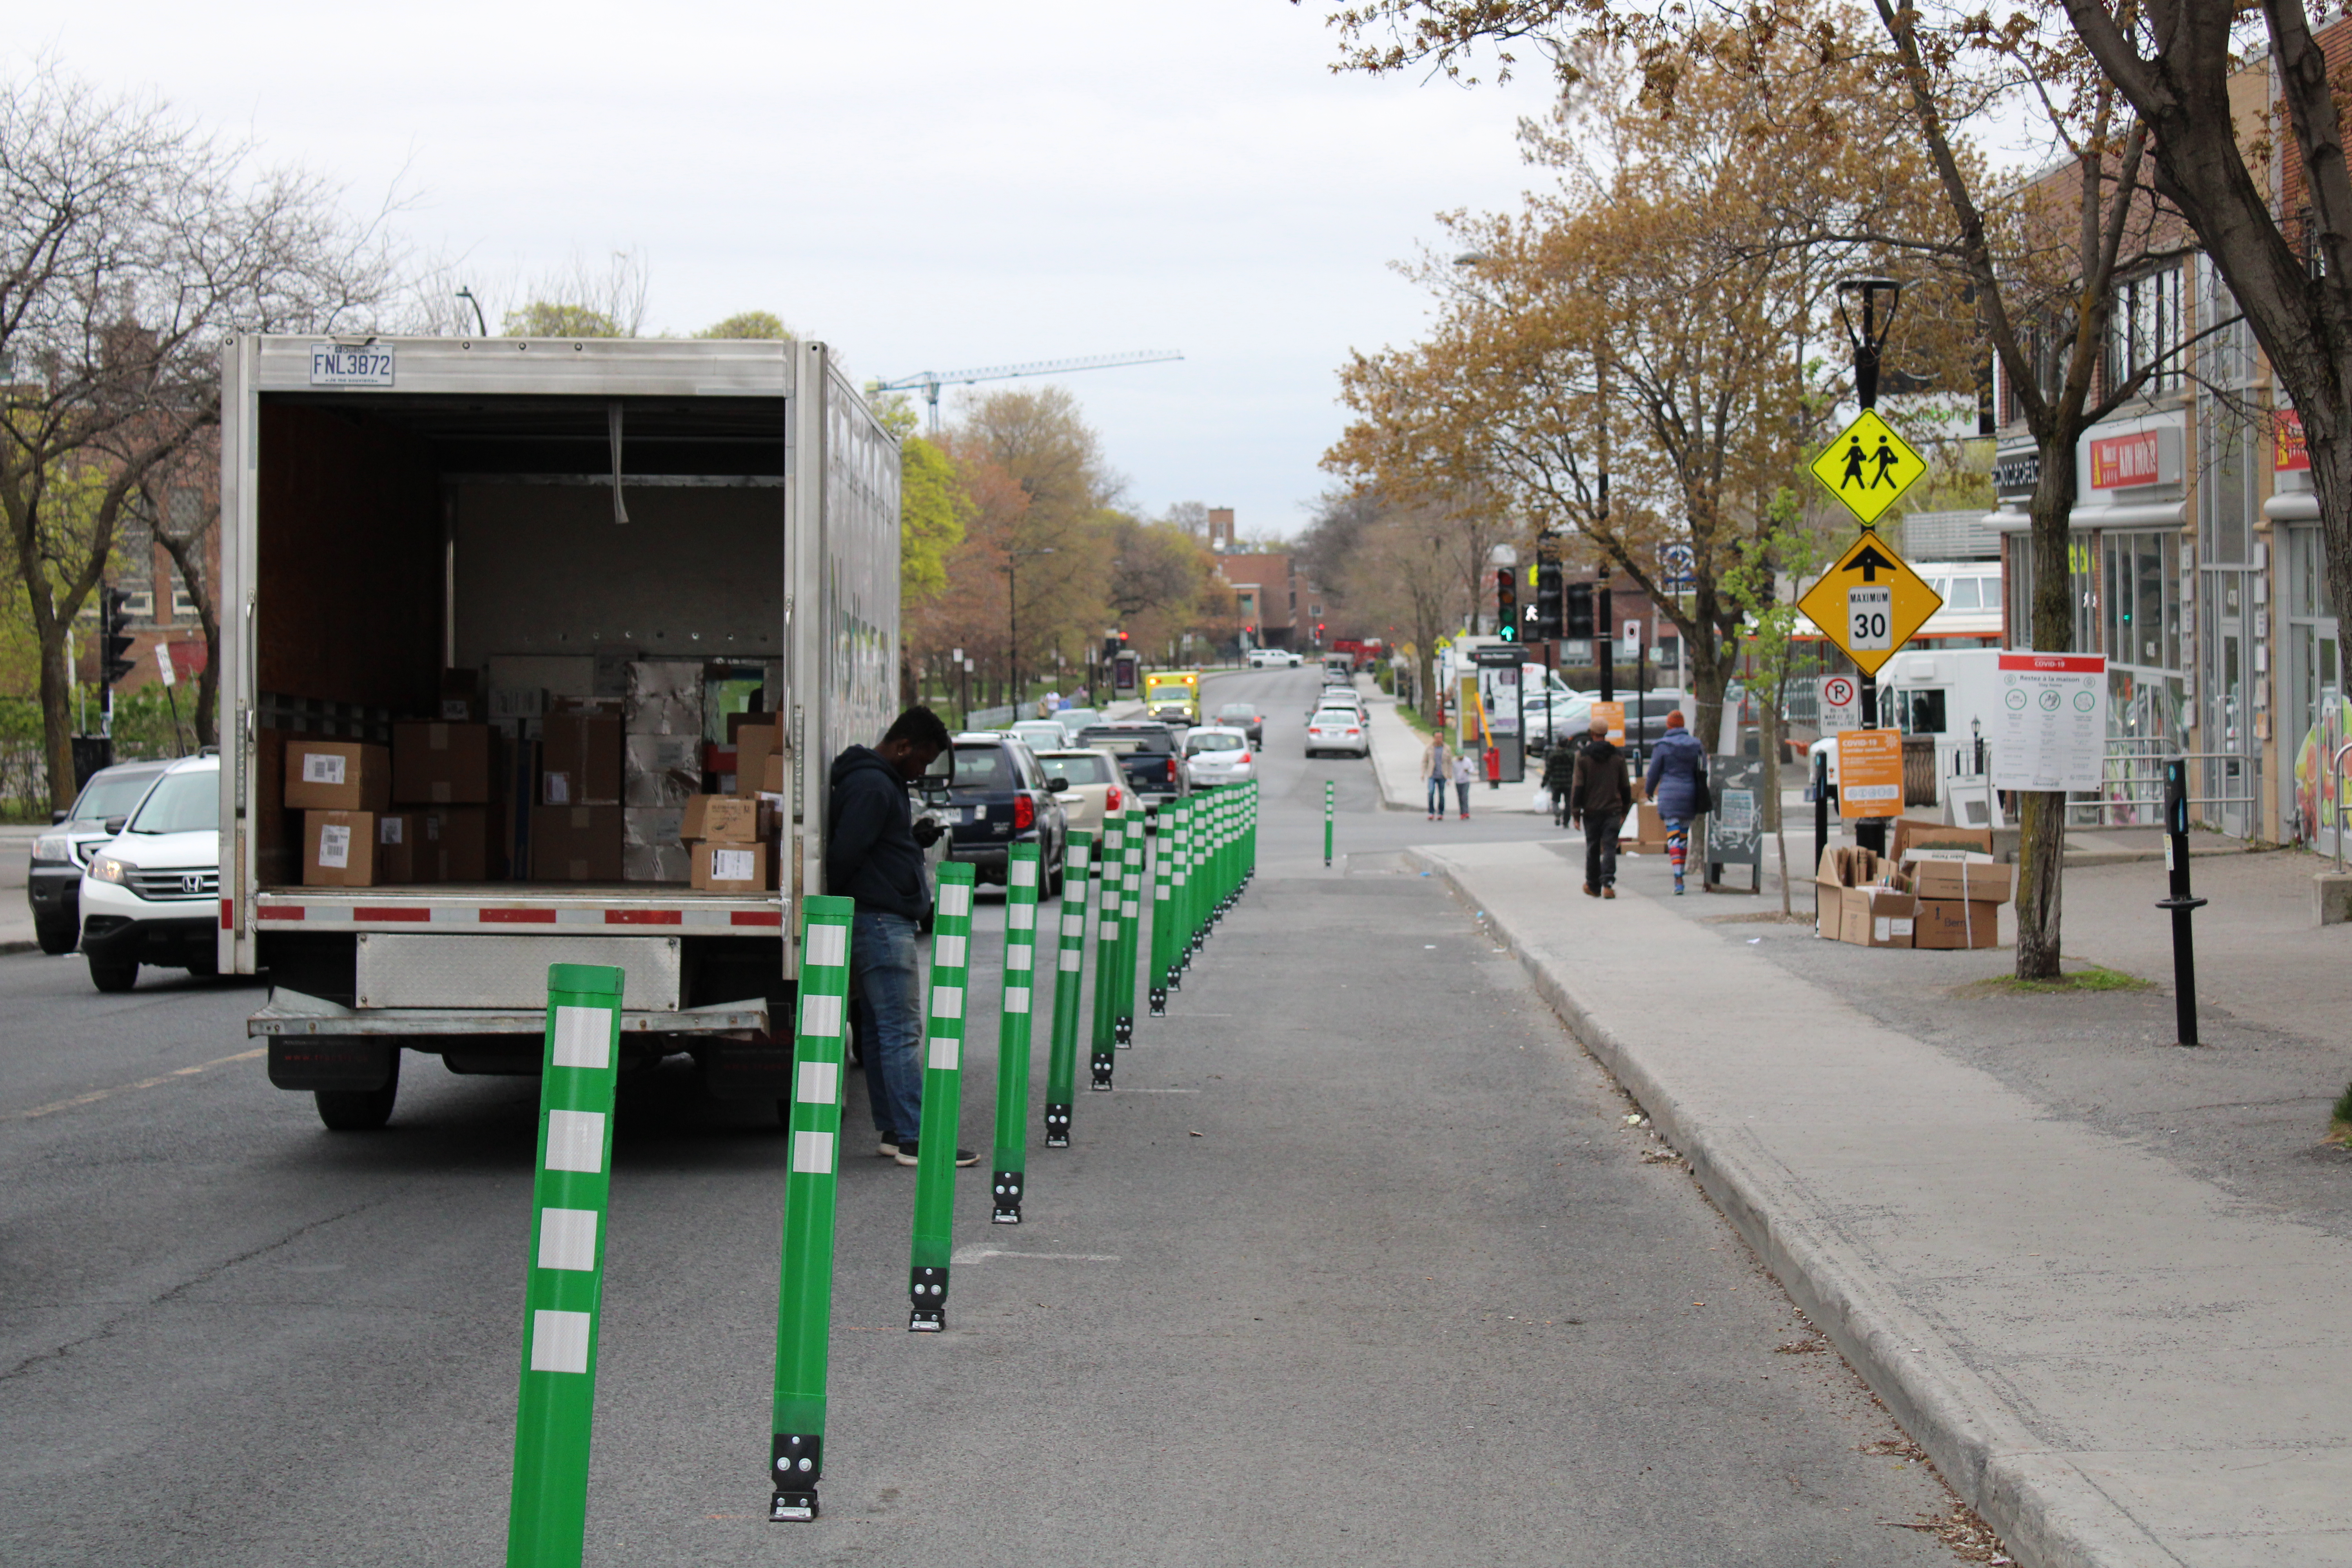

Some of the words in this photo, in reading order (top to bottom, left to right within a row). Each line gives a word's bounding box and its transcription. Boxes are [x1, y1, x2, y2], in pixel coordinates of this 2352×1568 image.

[314, 354, 390, 375] FNL3872
[1850, 593, 1888, 603] MAXIMUM
[1855, 613, 1886, 638] 30
